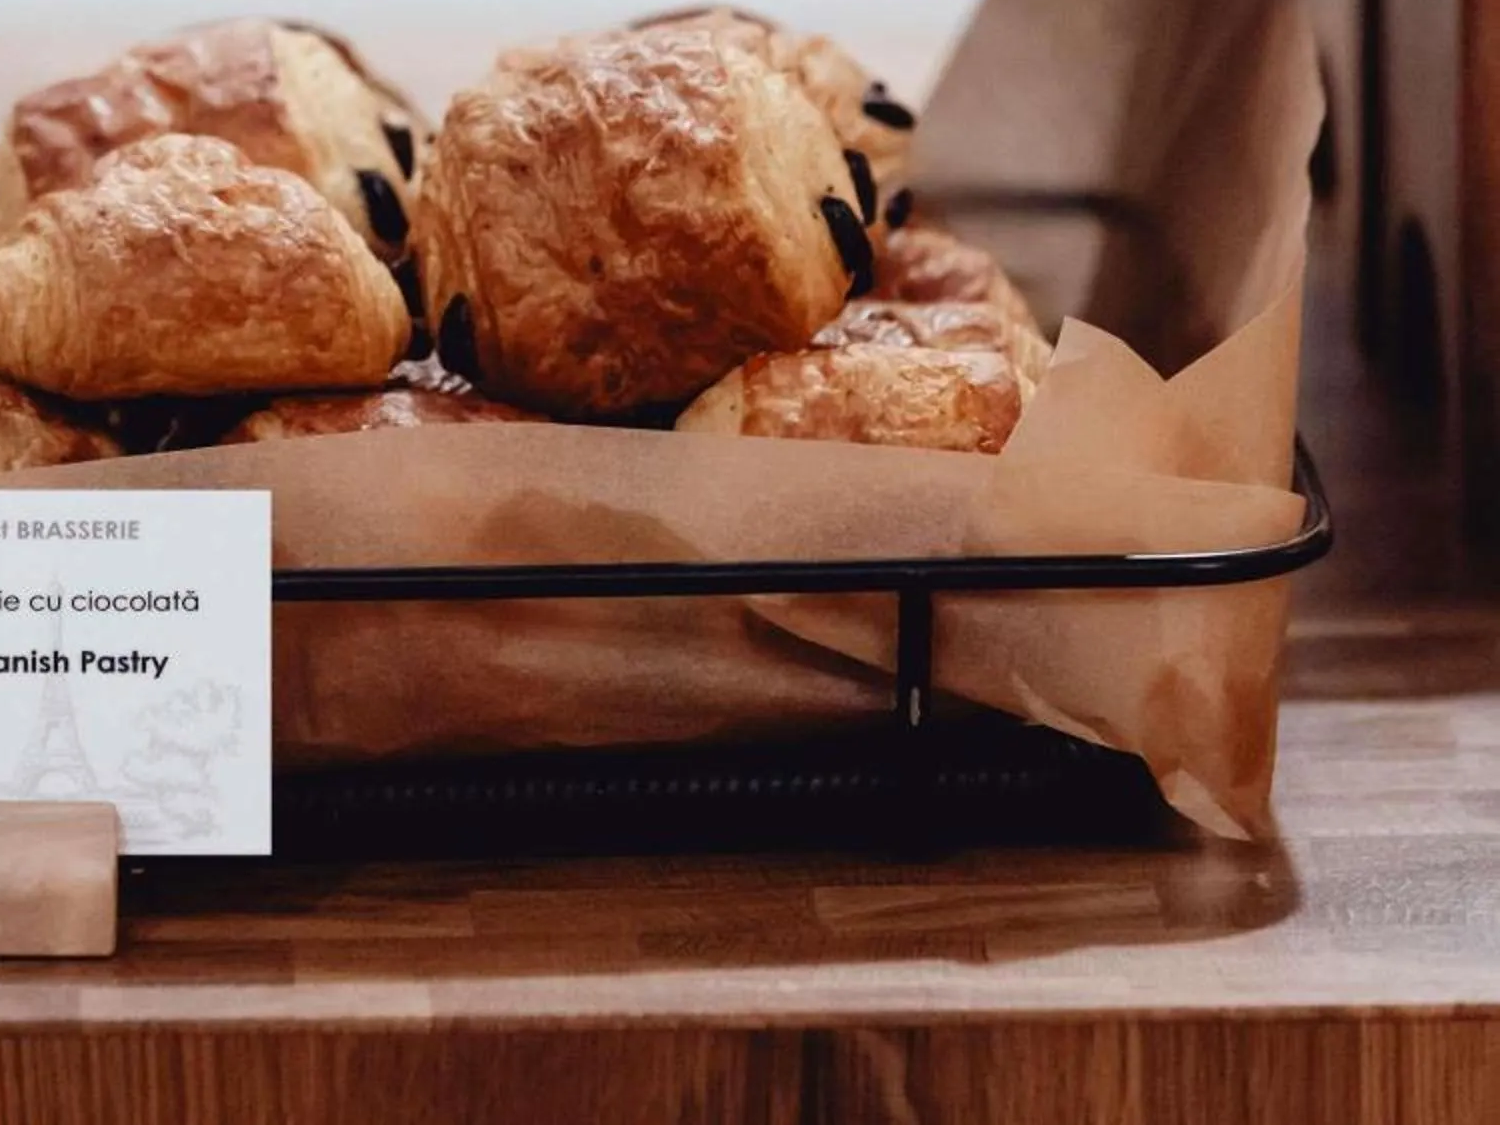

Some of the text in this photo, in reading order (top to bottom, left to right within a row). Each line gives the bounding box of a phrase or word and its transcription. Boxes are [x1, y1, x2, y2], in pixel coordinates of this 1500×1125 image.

[17, 520, 139, 540] BRASSERIE
[28, 594, 63, 613] cu
[70, 589, 200, 613] ciocolată
[80, 649, 169, 680] Pastry
